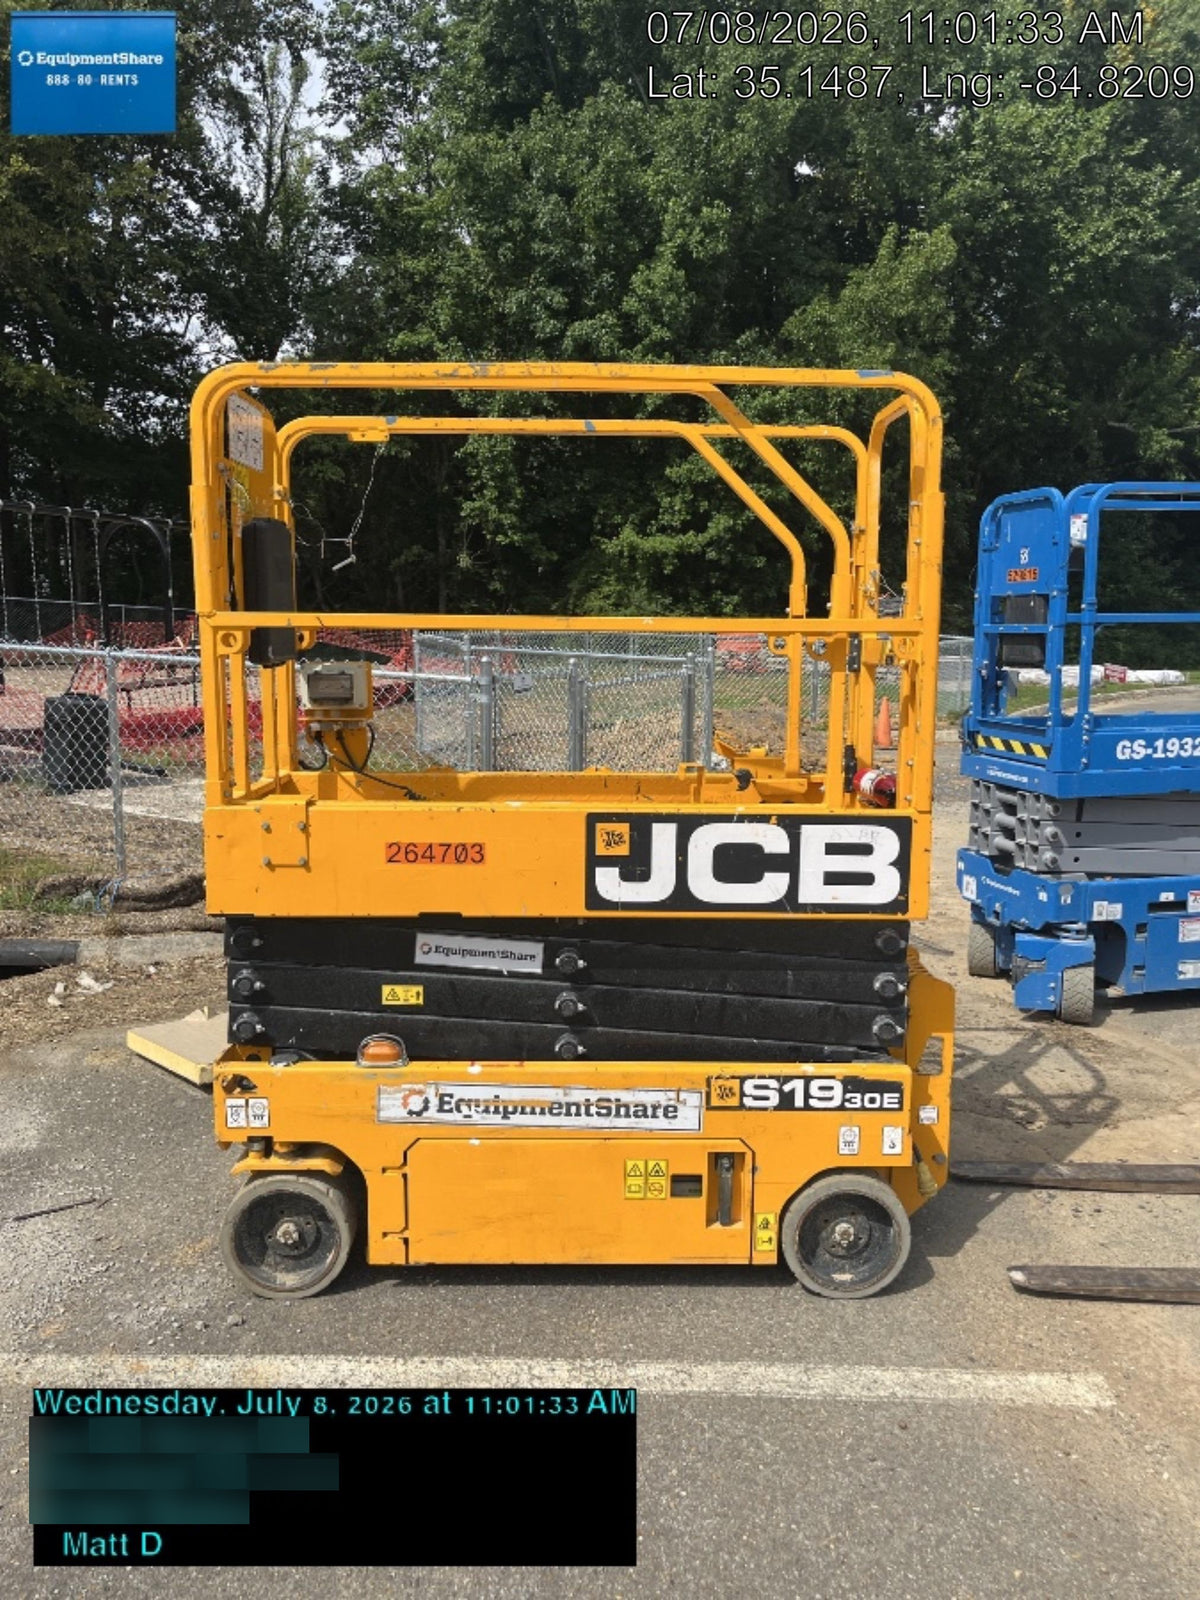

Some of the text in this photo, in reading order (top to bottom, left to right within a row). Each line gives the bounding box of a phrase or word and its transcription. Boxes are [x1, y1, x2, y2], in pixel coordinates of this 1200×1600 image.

[386, 842, 485, 864] 264703
[594, 822, 901, 904] JCB
[433, 944, 537, 962] EquipmentShare
